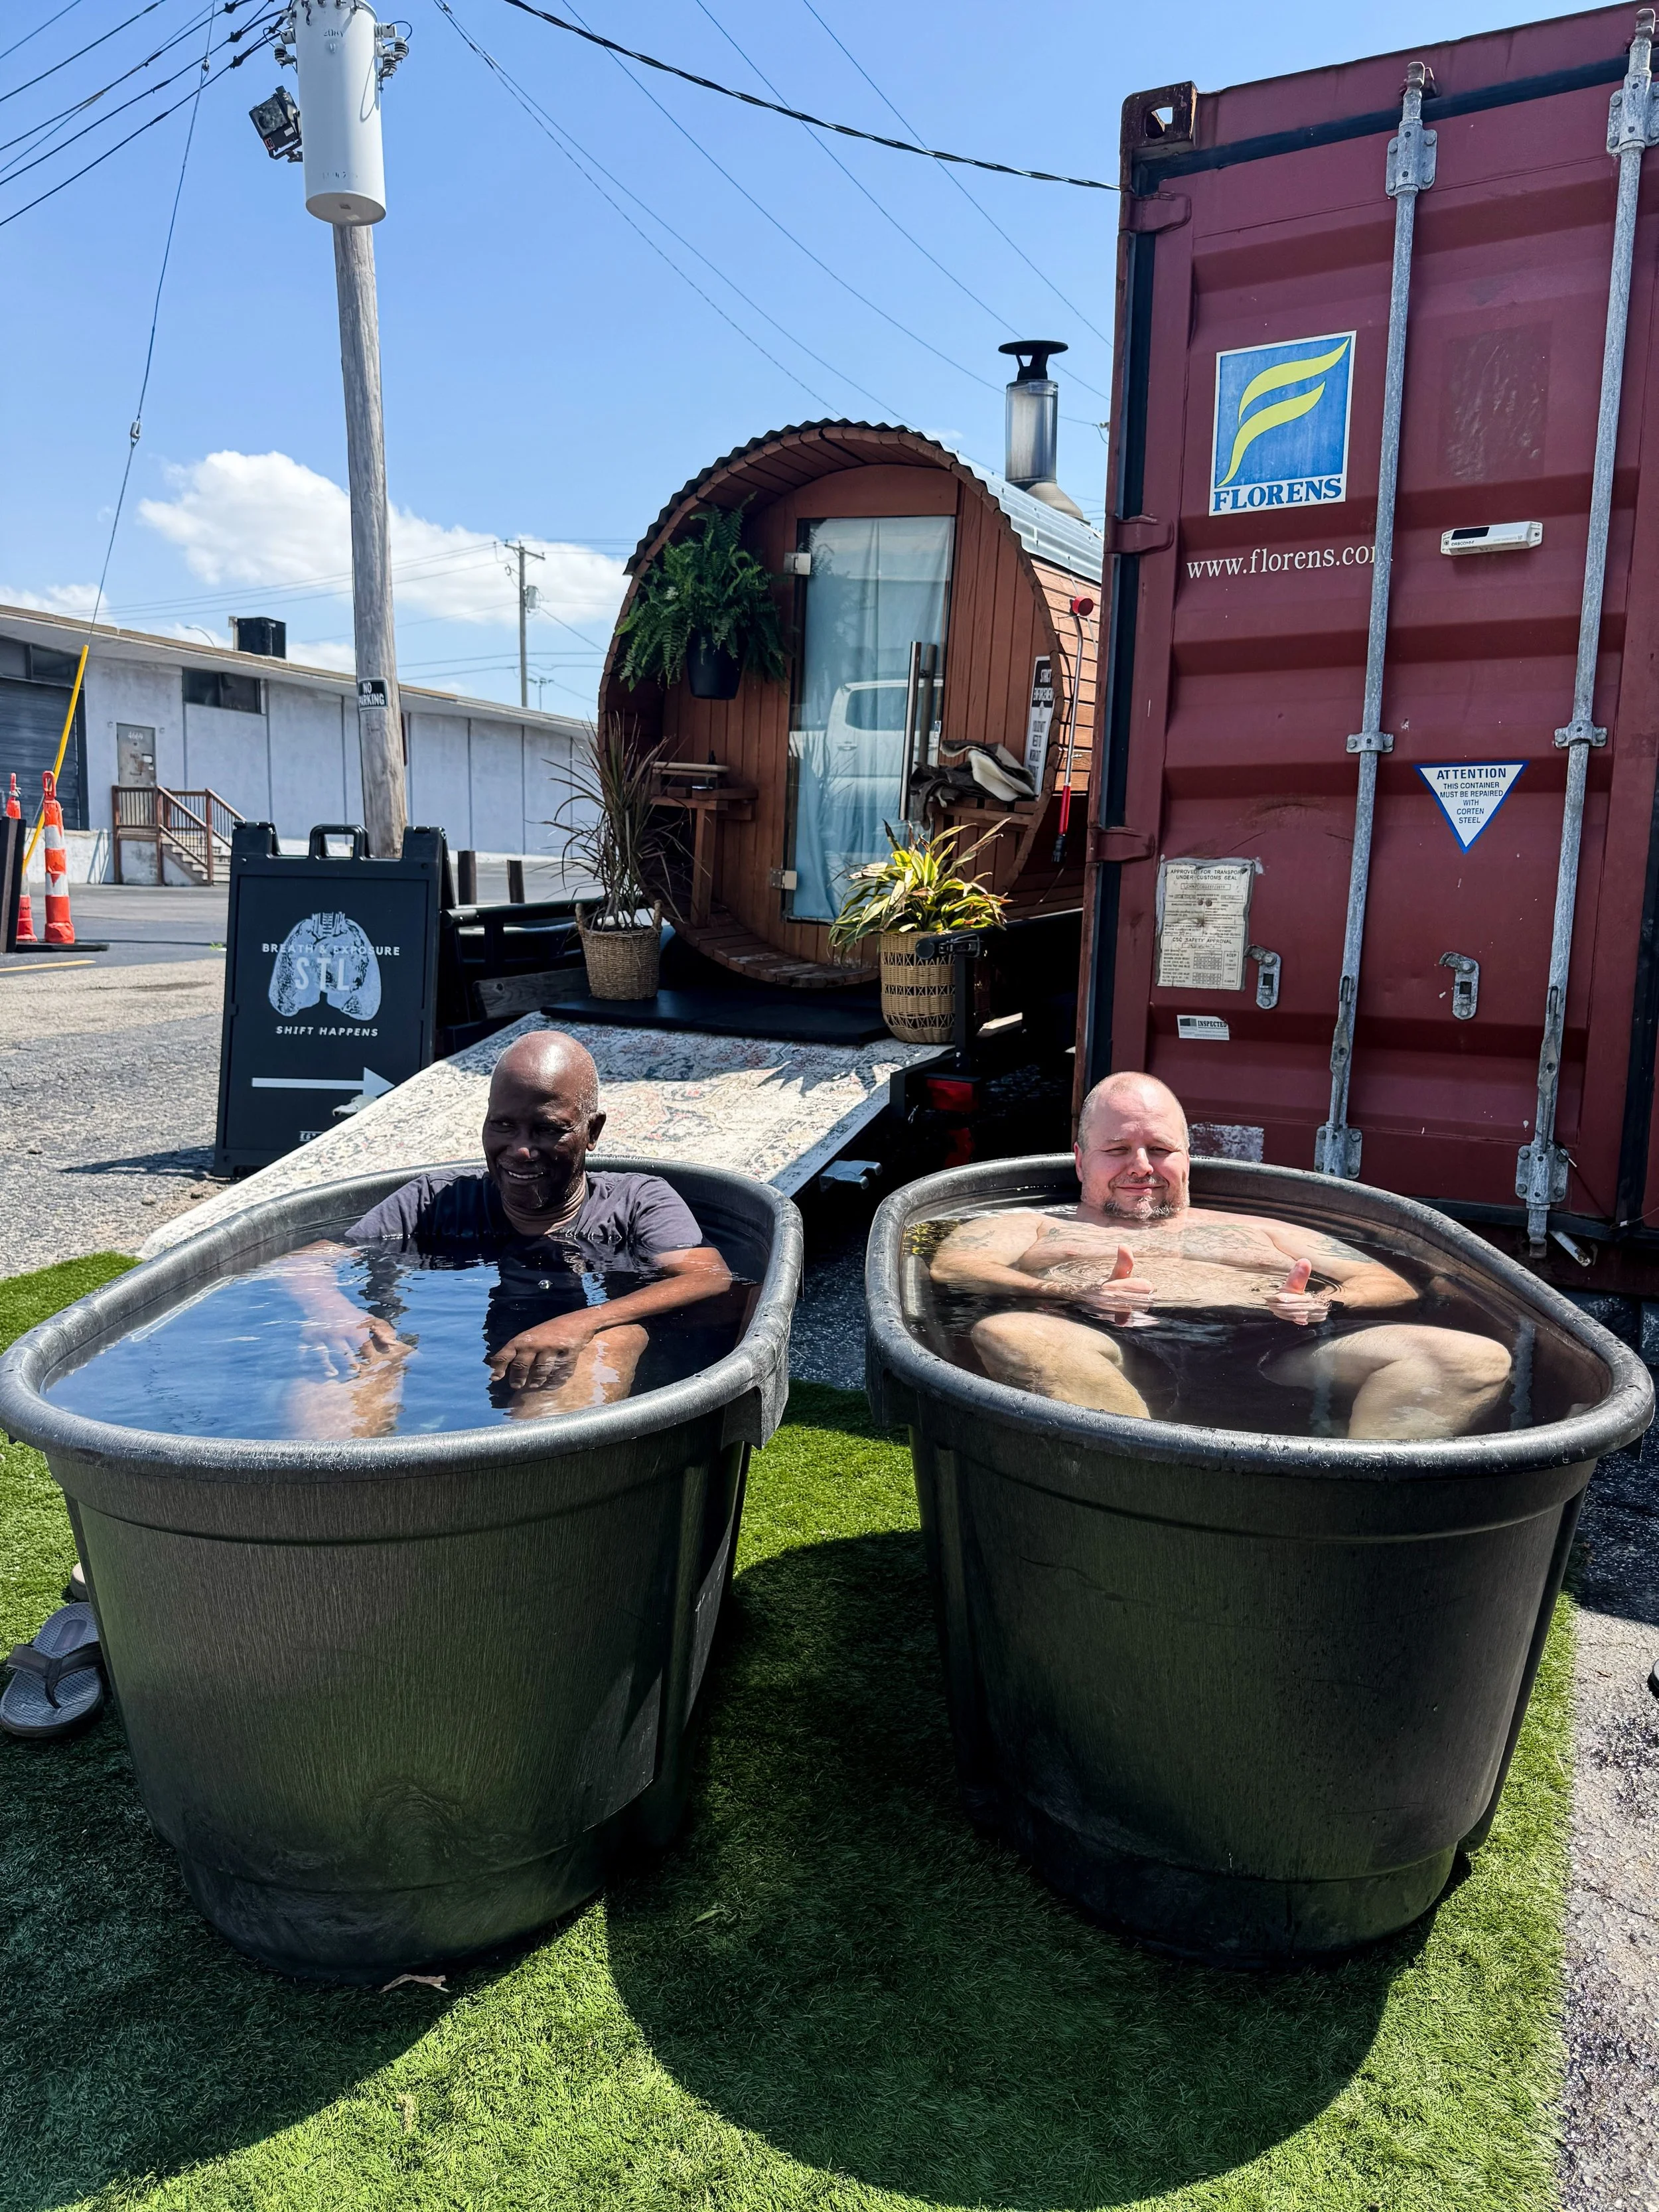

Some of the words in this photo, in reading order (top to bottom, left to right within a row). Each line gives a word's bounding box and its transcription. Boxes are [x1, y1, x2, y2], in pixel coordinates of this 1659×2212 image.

[1213, 477, 1342, 512] FLORENS
[363, 682, 372, 694] NO
[1437, 768, 1506, 780] ATTENTION
[261, 943, 313, 953] BREATH
[334, 946, 400, 956] EXPOSURE
[295, 957, 350, 991] STL
[275, 1025, 314, 1035] SHIFT
[319, 1027, 379, 1037] HAPPENS
